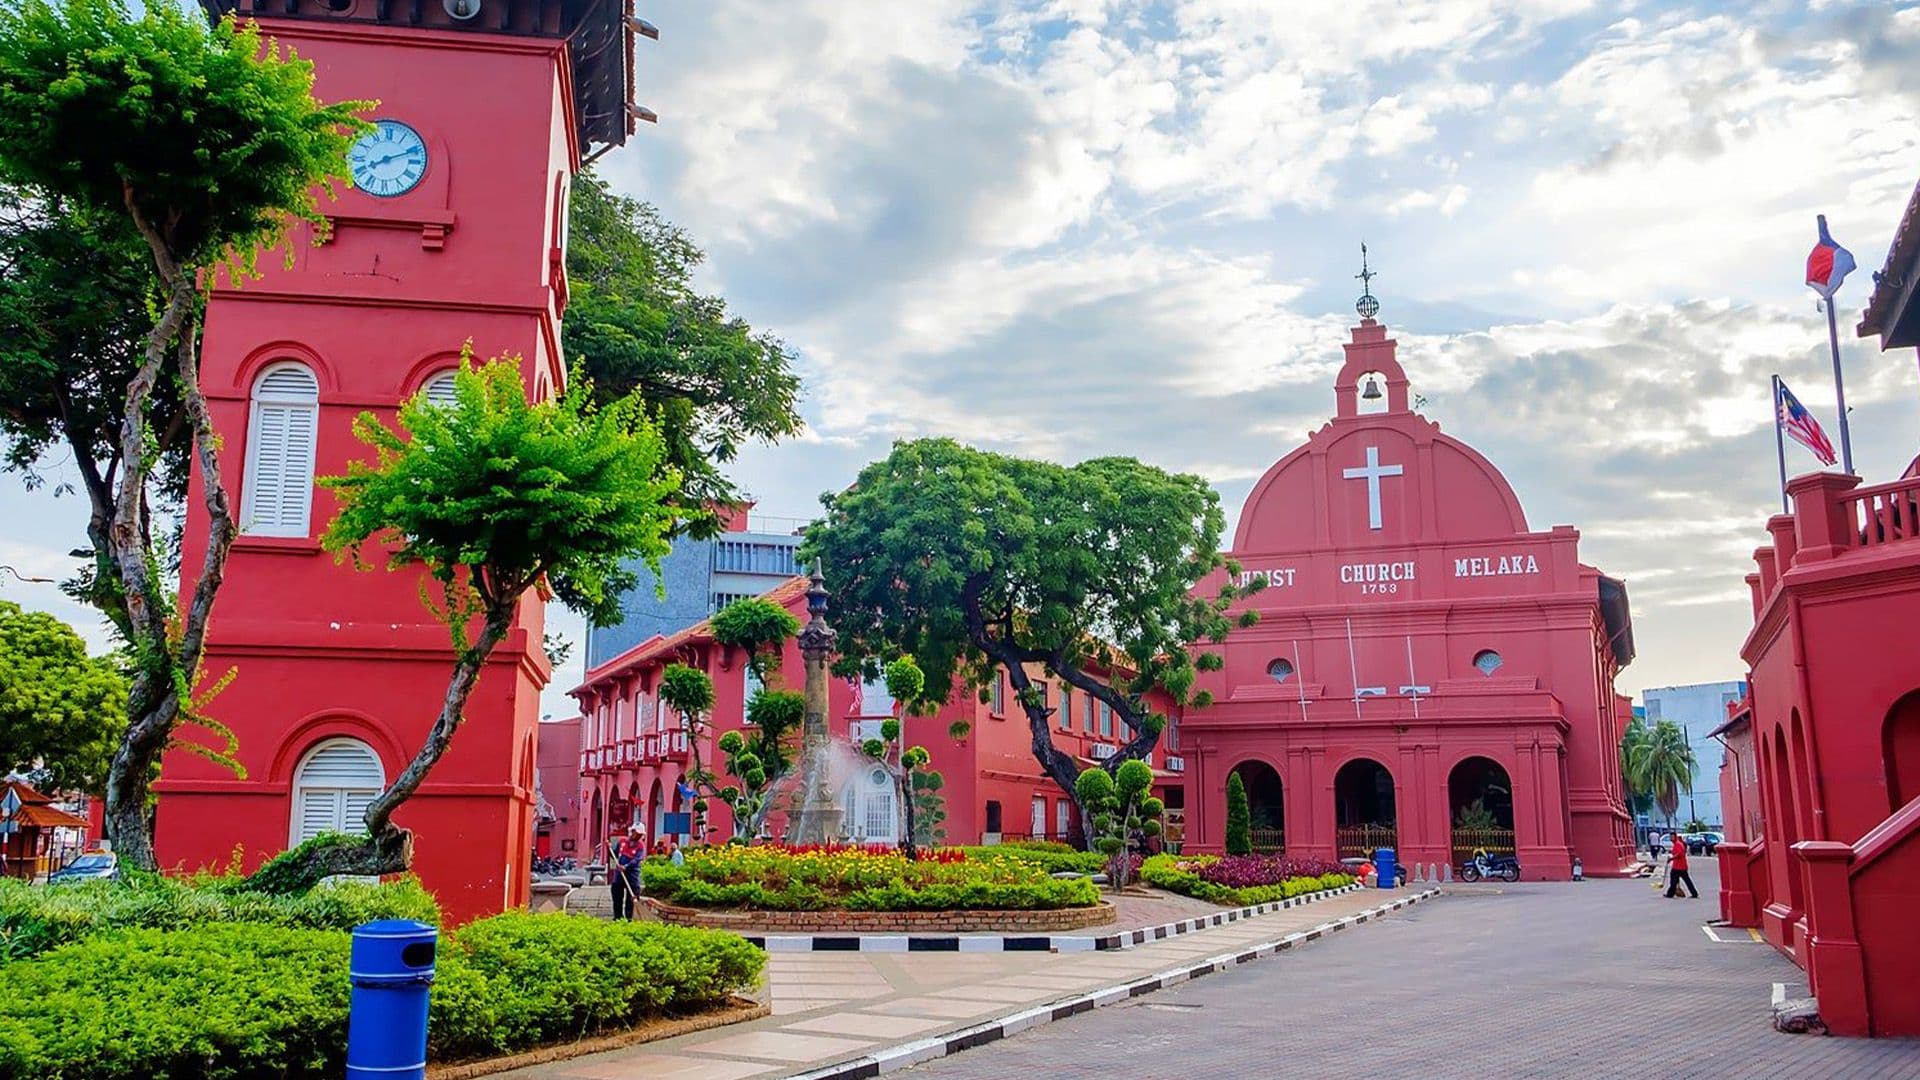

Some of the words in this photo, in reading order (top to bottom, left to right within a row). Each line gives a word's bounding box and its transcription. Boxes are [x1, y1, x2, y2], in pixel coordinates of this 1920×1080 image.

[1340, 561, 1415, 583] CHURCH
[1454, 554, 1540, 577] MELAKA
[1362, 583, 1397, 594] 1753
